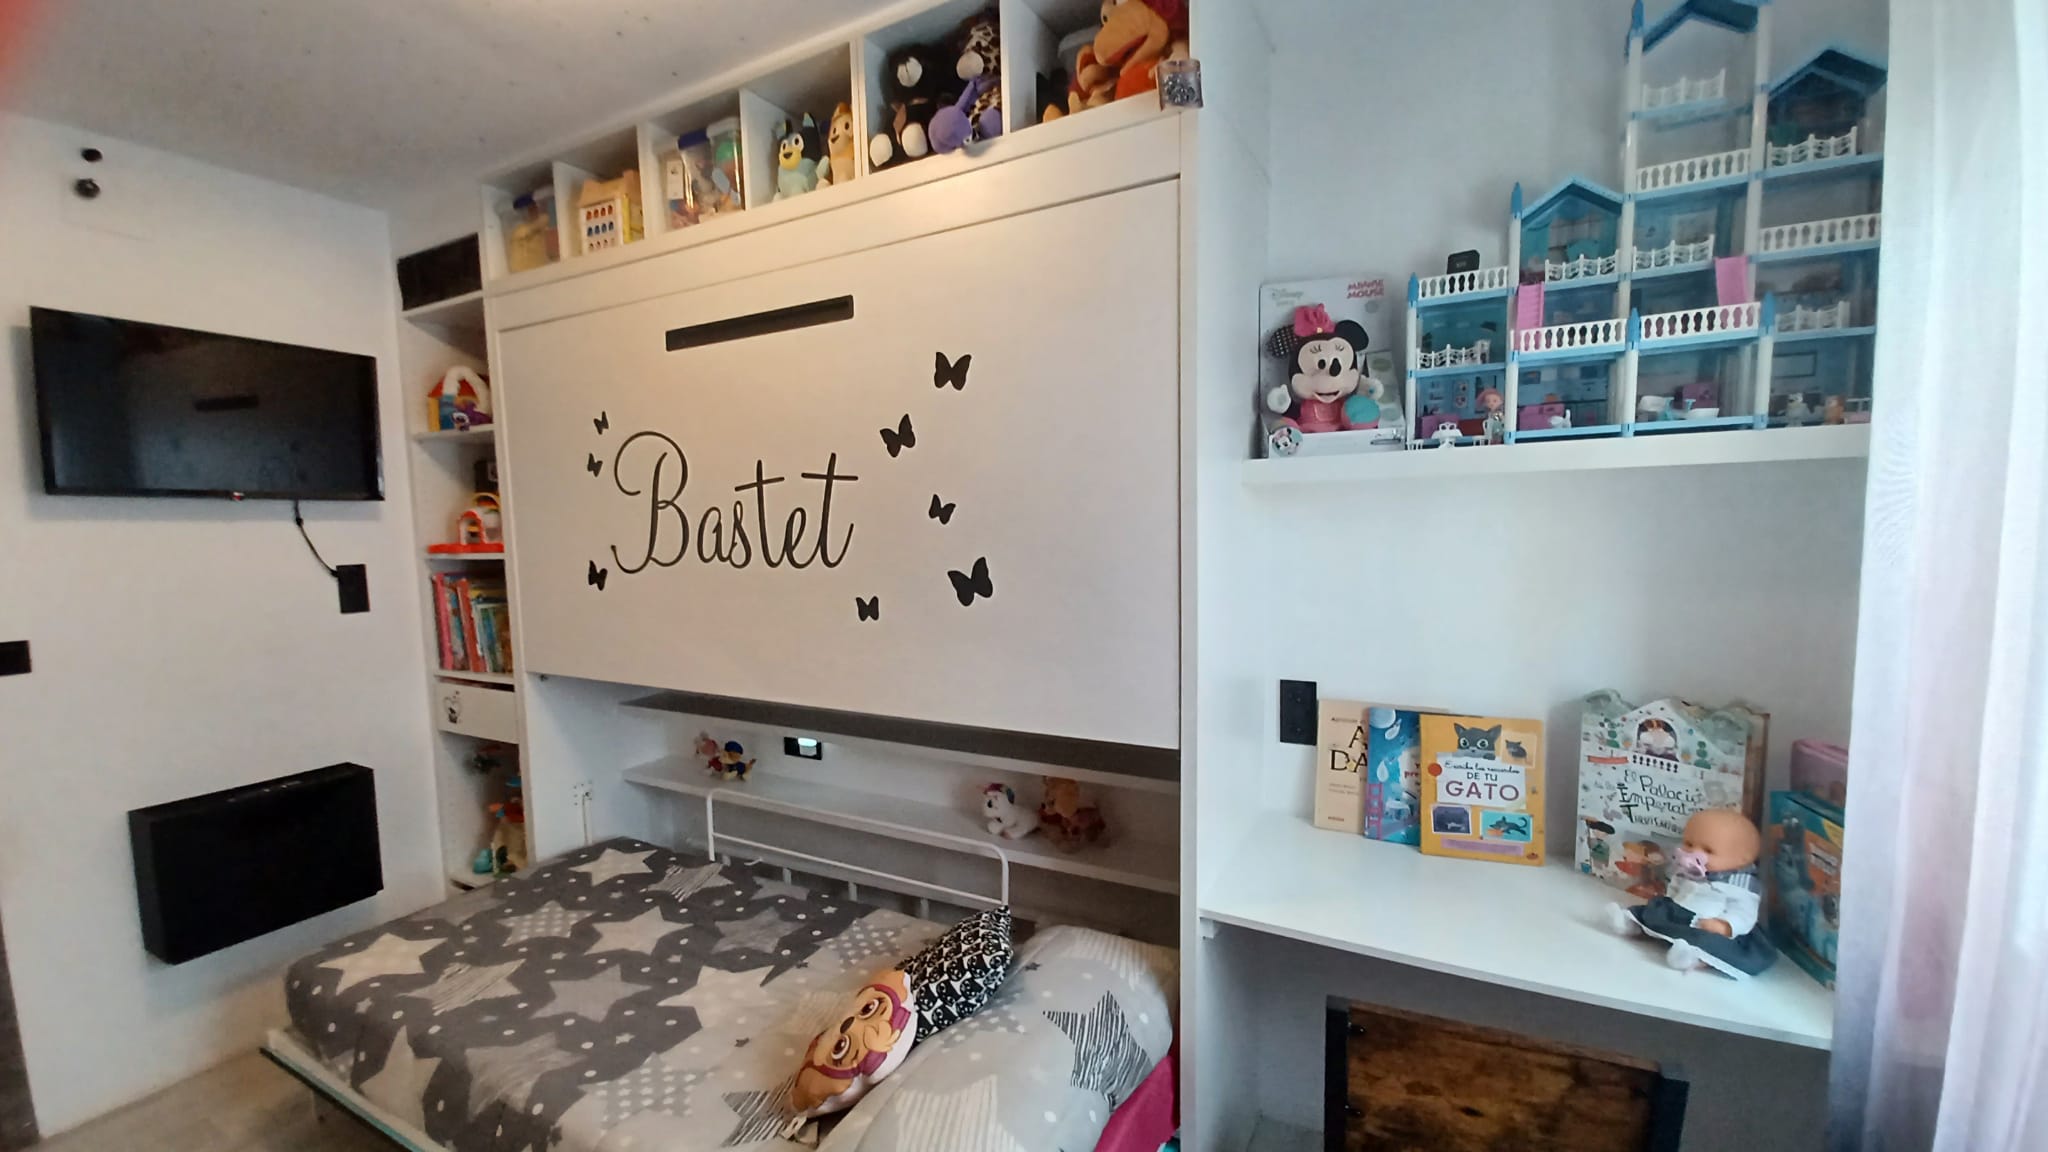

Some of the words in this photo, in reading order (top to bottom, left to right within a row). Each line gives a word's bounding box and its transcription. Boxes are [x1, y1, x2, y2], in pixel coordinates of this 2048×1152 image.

[611, 431, 858, 574] Bastet
[1467, 771, 1480, 780] DE
[1485, 773, 1498, 782] TU
[1445, 780, 1519, 801] GATO
